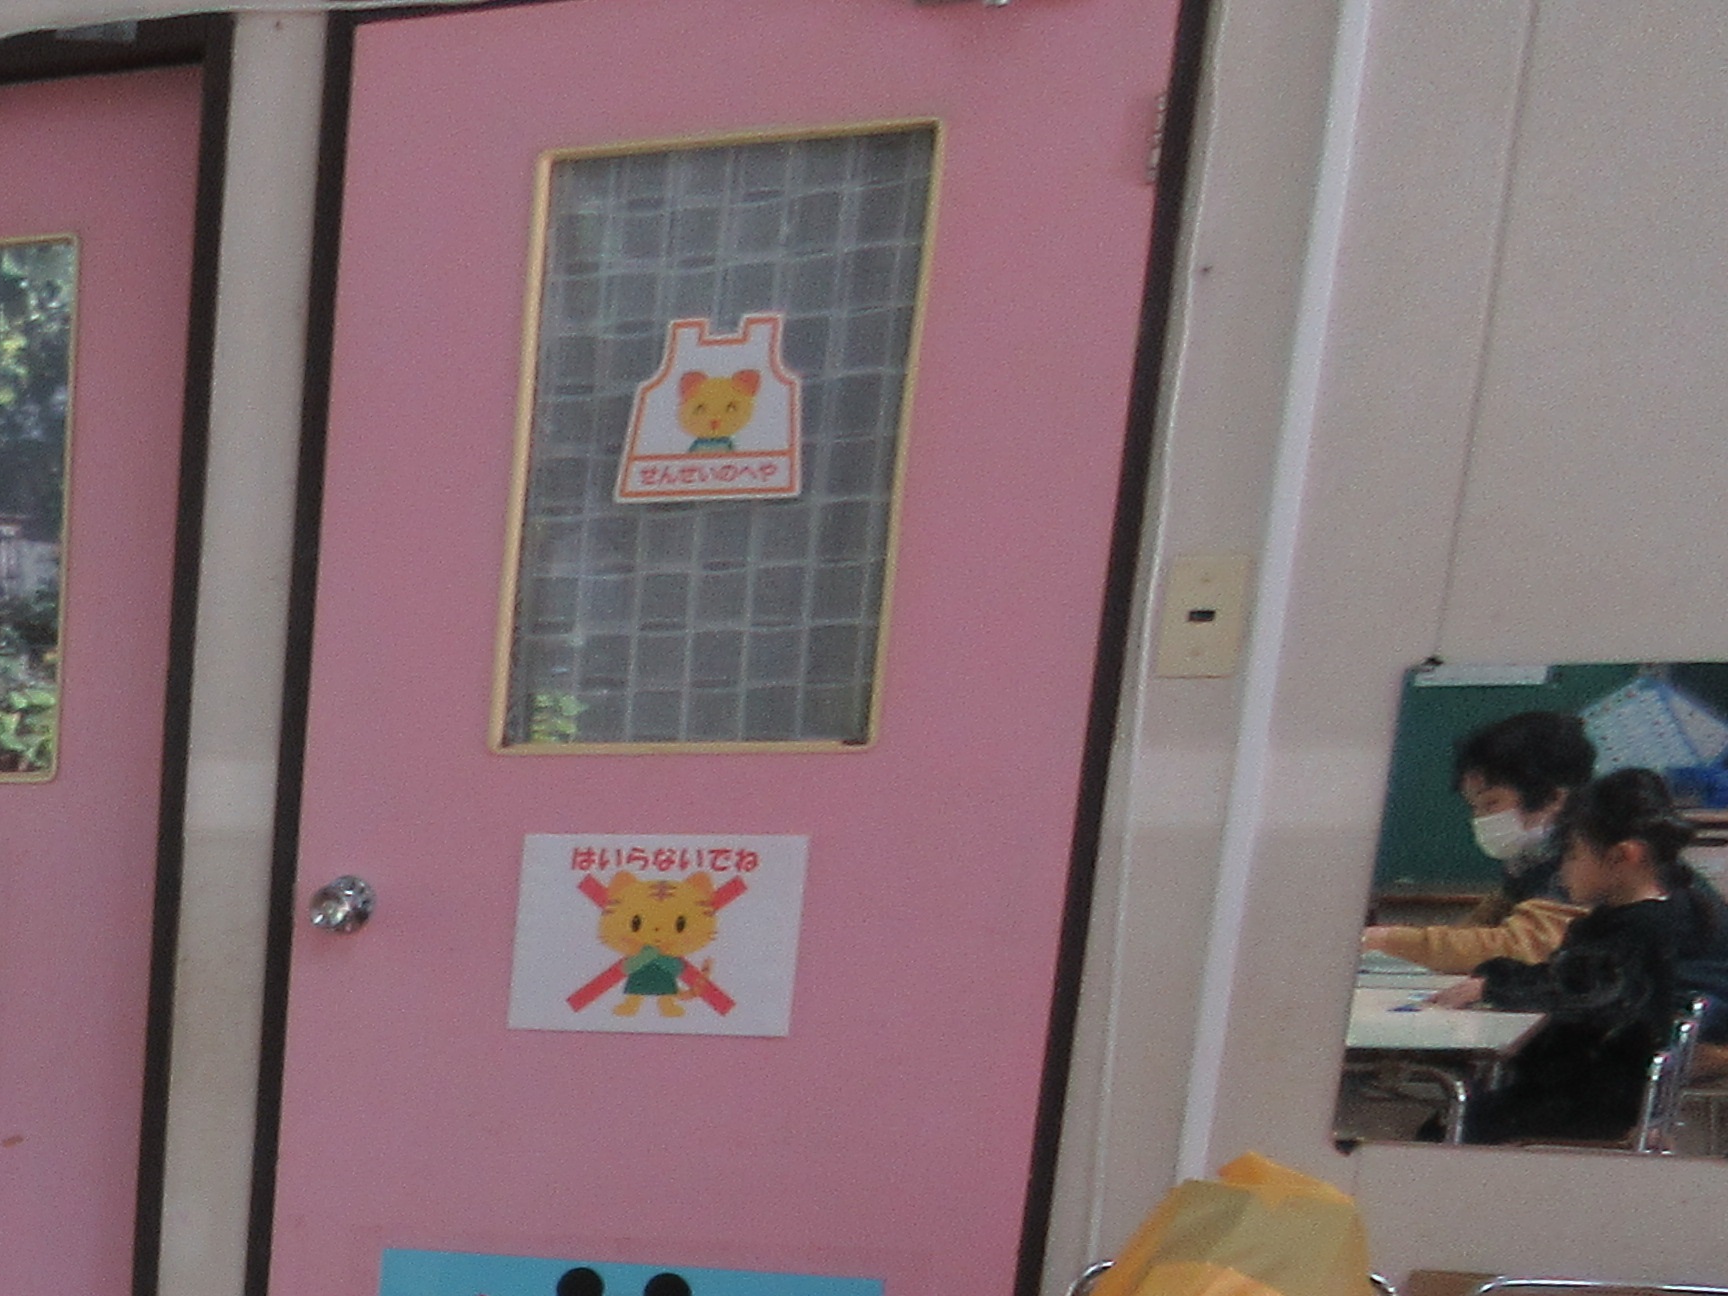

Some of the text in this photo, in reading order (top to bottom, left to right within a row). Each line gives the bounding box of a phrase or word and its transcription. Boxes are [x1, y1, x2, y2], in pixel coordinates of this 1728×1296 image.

[570, 845, 761, 873] はいらないでね
